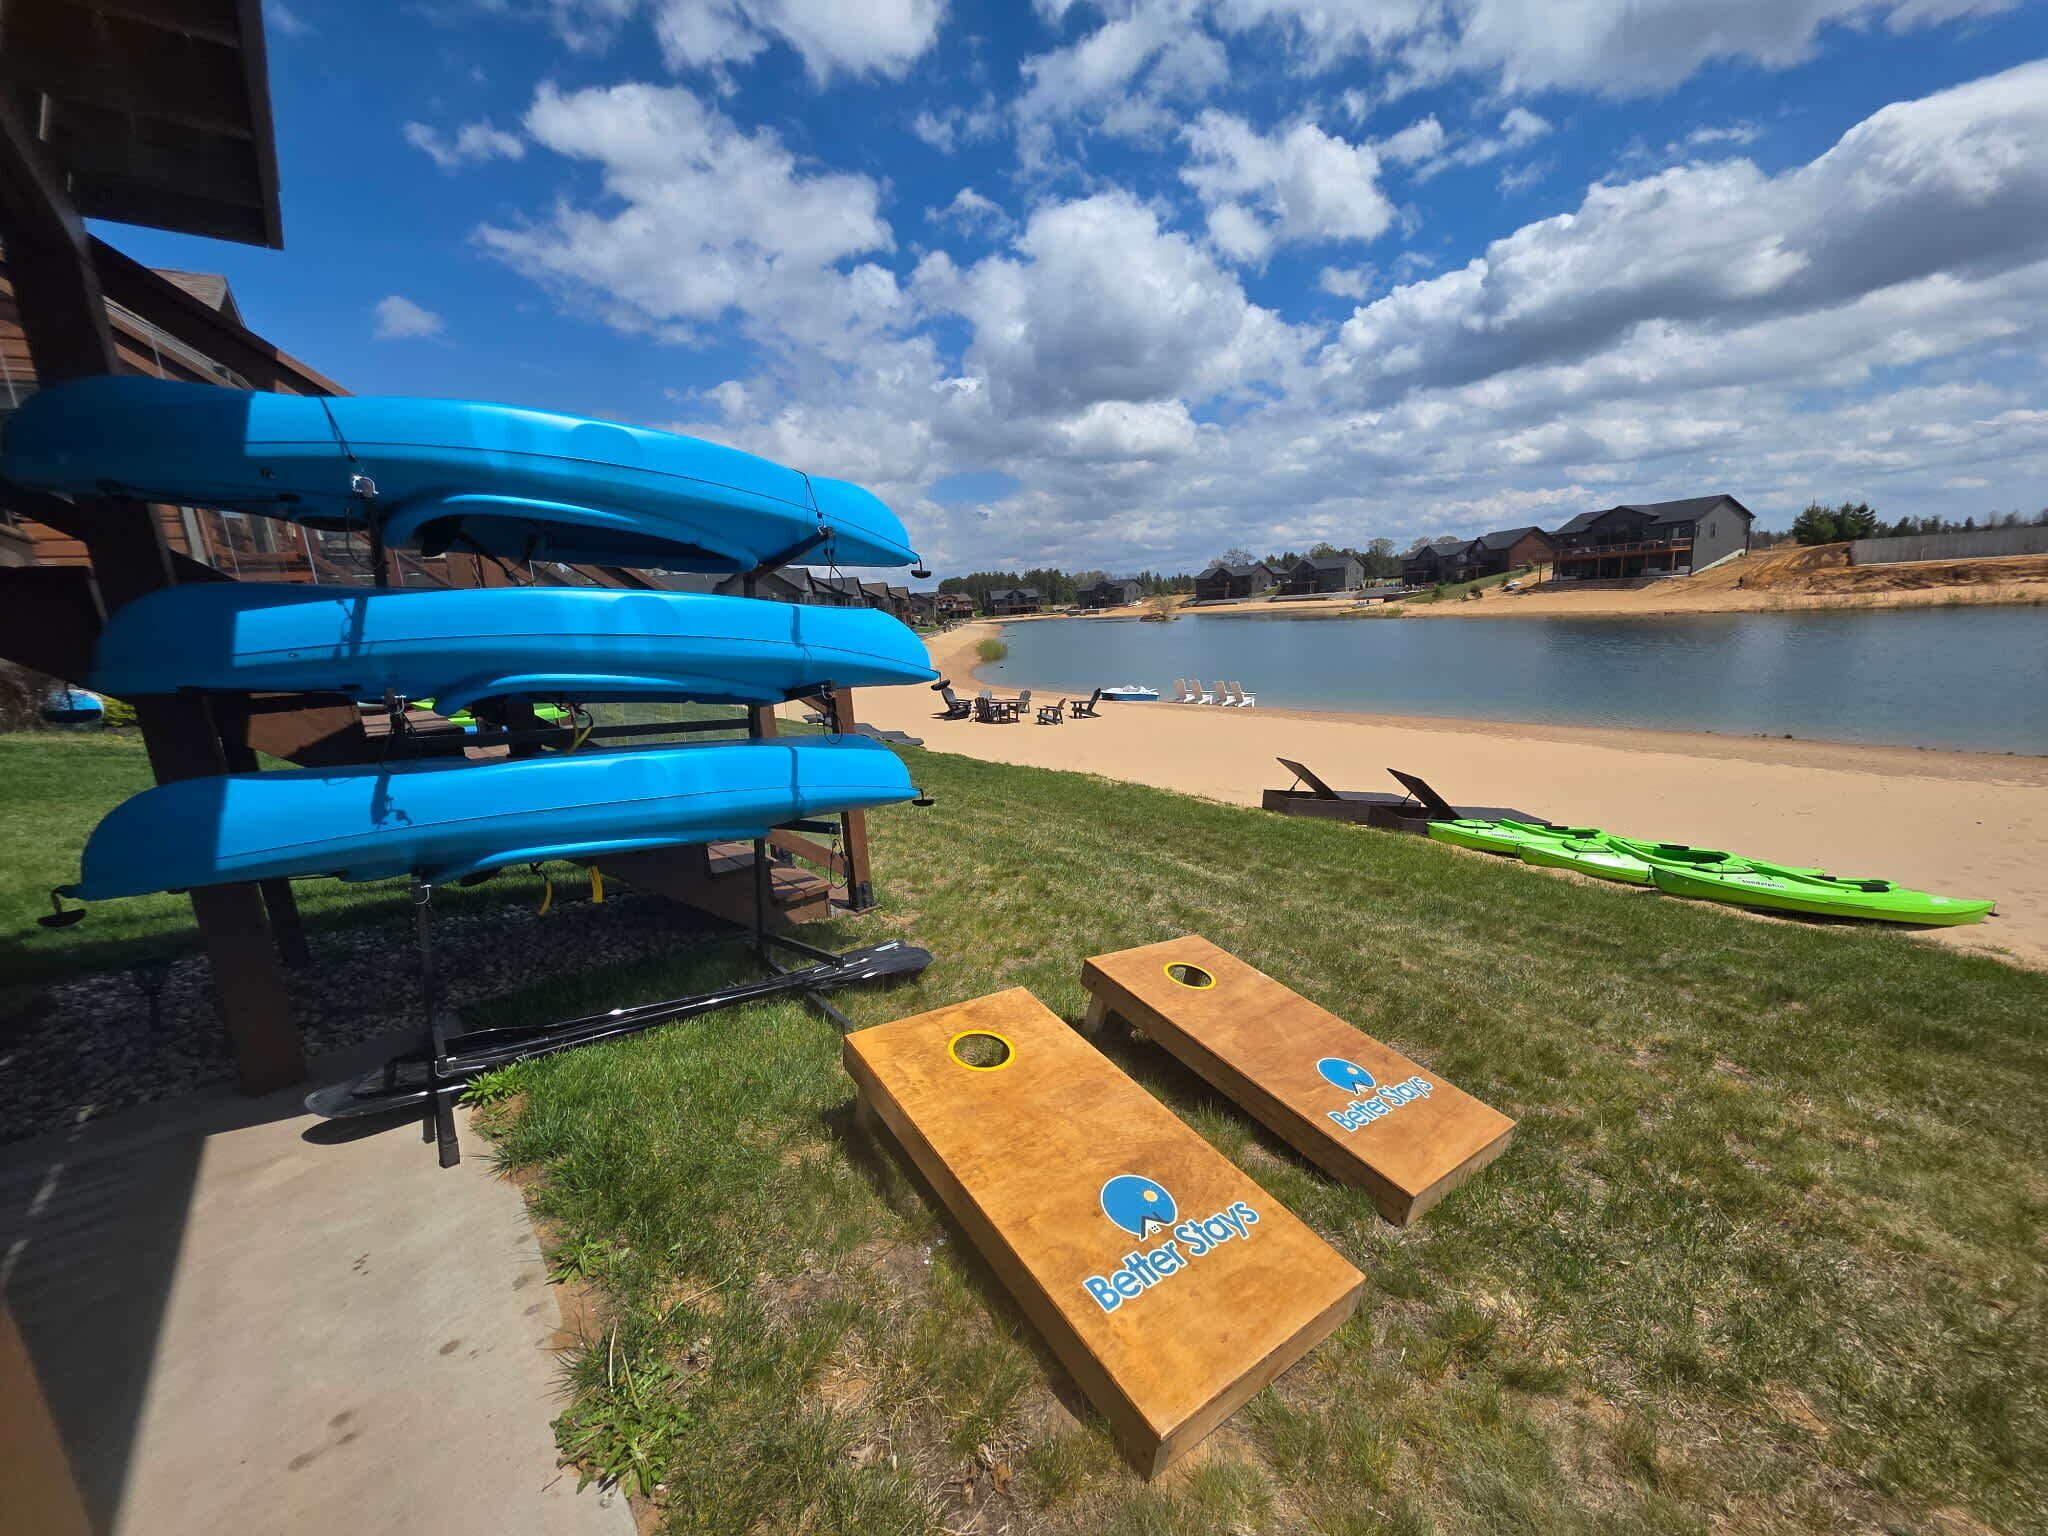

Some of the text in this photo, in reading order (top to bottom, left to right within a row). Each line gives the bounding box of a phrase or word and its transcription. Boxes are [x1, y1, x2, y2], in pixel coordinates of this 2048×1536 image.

[1327, 1076, 1433, 1132] Better Stays
[1083, 1202, 1259, 1313] Better Stays
